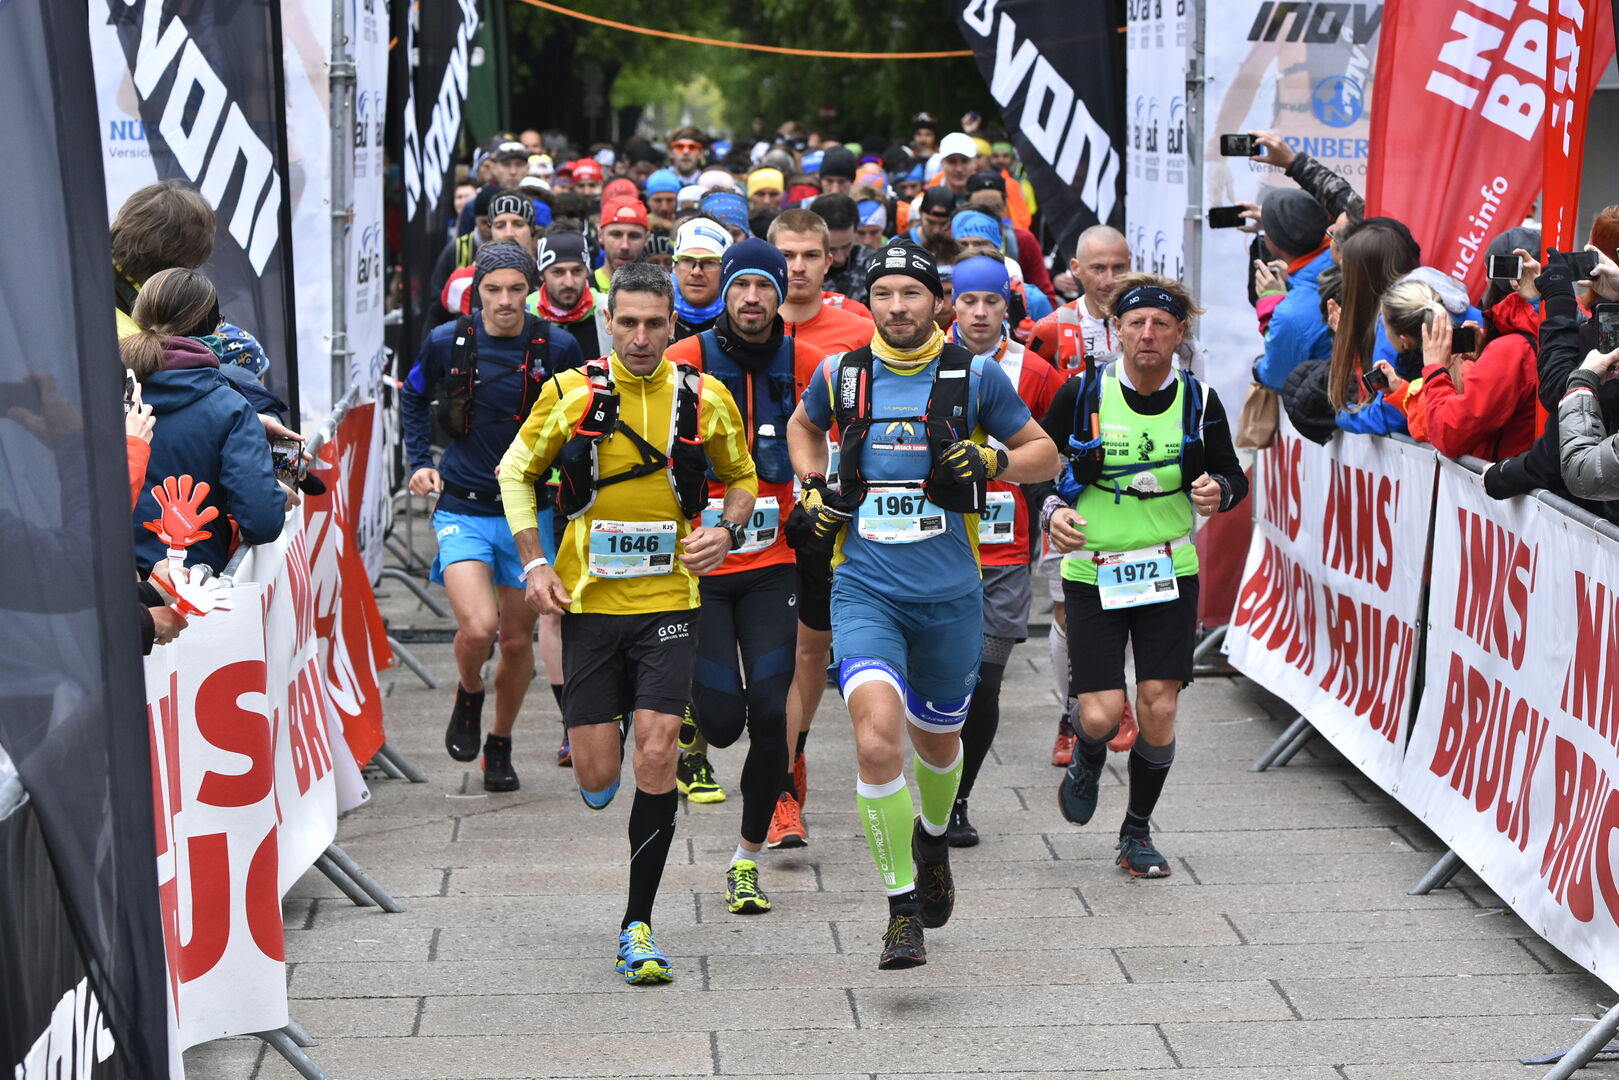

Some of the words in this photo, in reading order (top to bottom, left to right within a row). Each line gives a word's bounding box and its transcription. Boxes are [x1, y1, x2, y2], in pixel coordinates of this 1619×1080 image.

[843, 377, 851, 408] POWER
[874, 495, 927, 516] 1967
[1322, 457, 1400, 592] INNS'
[607, 535, 660, 553] 1646
[1113, 561, 1160, 583] 1972
[1454, 506, 1539, 671] INNS'
[658, 623, 689, 637] GORE
[1319, 583, 1413, 744] BRUCK
[1430, 651, 1549, 852] BRUCK
